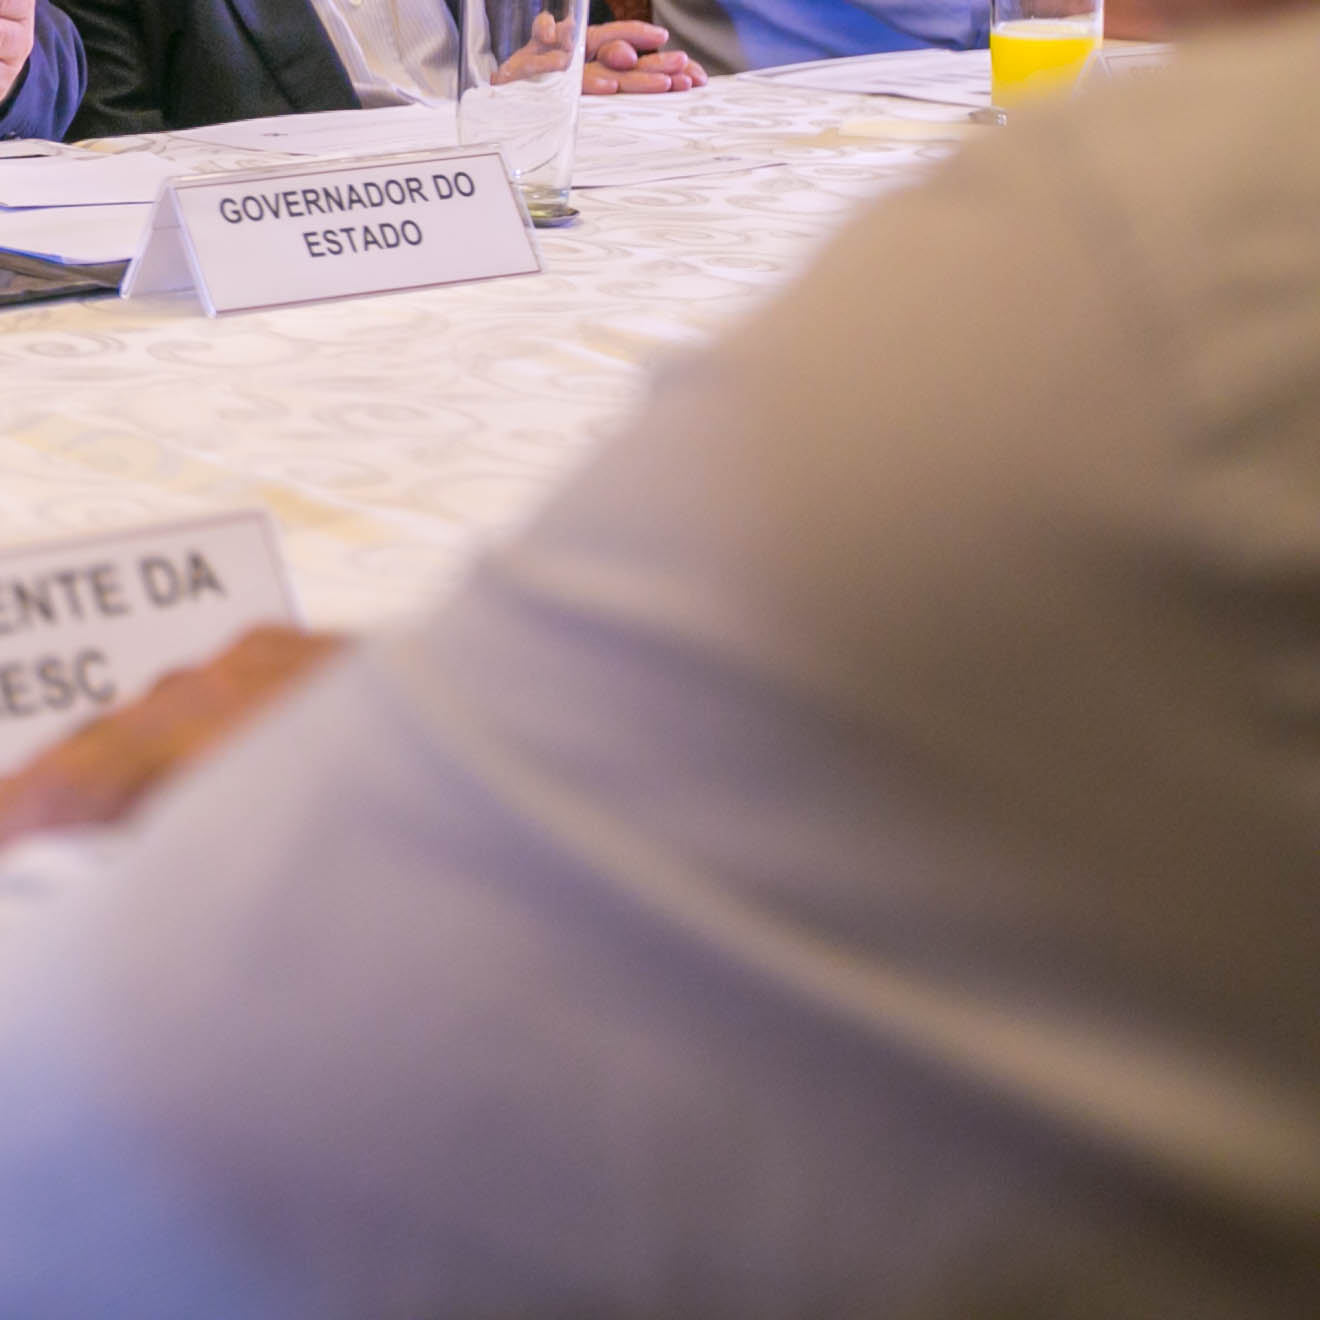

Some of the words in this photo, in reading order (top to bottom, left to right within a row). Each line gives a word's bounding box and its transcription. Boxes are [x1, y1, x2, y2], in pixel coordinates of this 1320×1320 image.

[218, 177, 428, 224] GOVERNADOR
[432, 171, 476, 200] DO
[303, 220, 423, 258] ESTADO
[141, 550, 225, 609] DA
